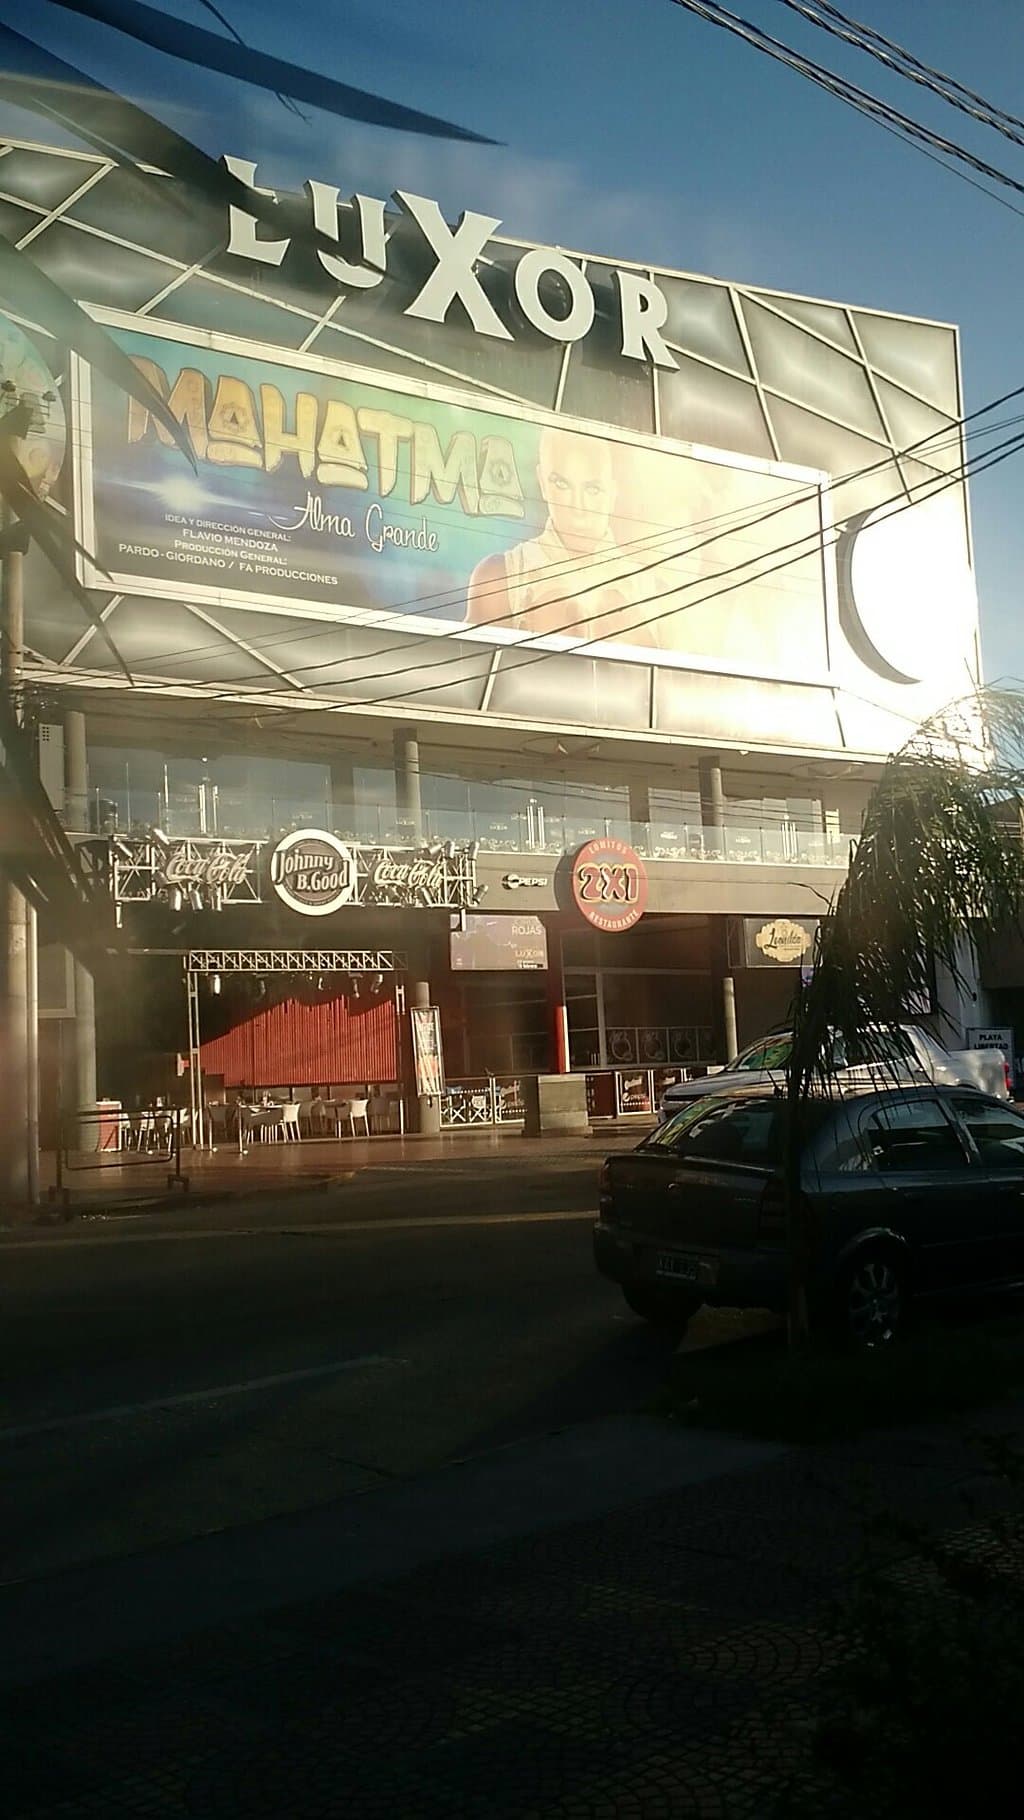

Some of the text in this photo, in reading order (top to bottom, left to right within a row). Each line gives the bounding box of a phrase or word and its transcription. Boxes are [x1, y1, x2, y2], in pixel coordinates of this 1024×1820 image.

[221, 154, 681, 371] LUXOR
[127, 354, 526, 520] MAHATMA
[164, 512, 188, 525] IDEA
[188, 517, 196, 526] Y
[246, 527, 292, 542] GENERAL:
[269, 491, 439, 553] Alma Grande
[182, 527, 279, 553] FLAVIO MENDOZA
[118, 543, 160, 558] PARDO
[165, 550, 226, 569] GIORDANO
[239, 561, 254, 573] FA
[254, 564, 339, 586] PRODUCCIONES
[278, 849, 334, 884] Johnny
[518, 876, 548, 887] PEPSI
[511, 925, 542, 936] ROJAS
